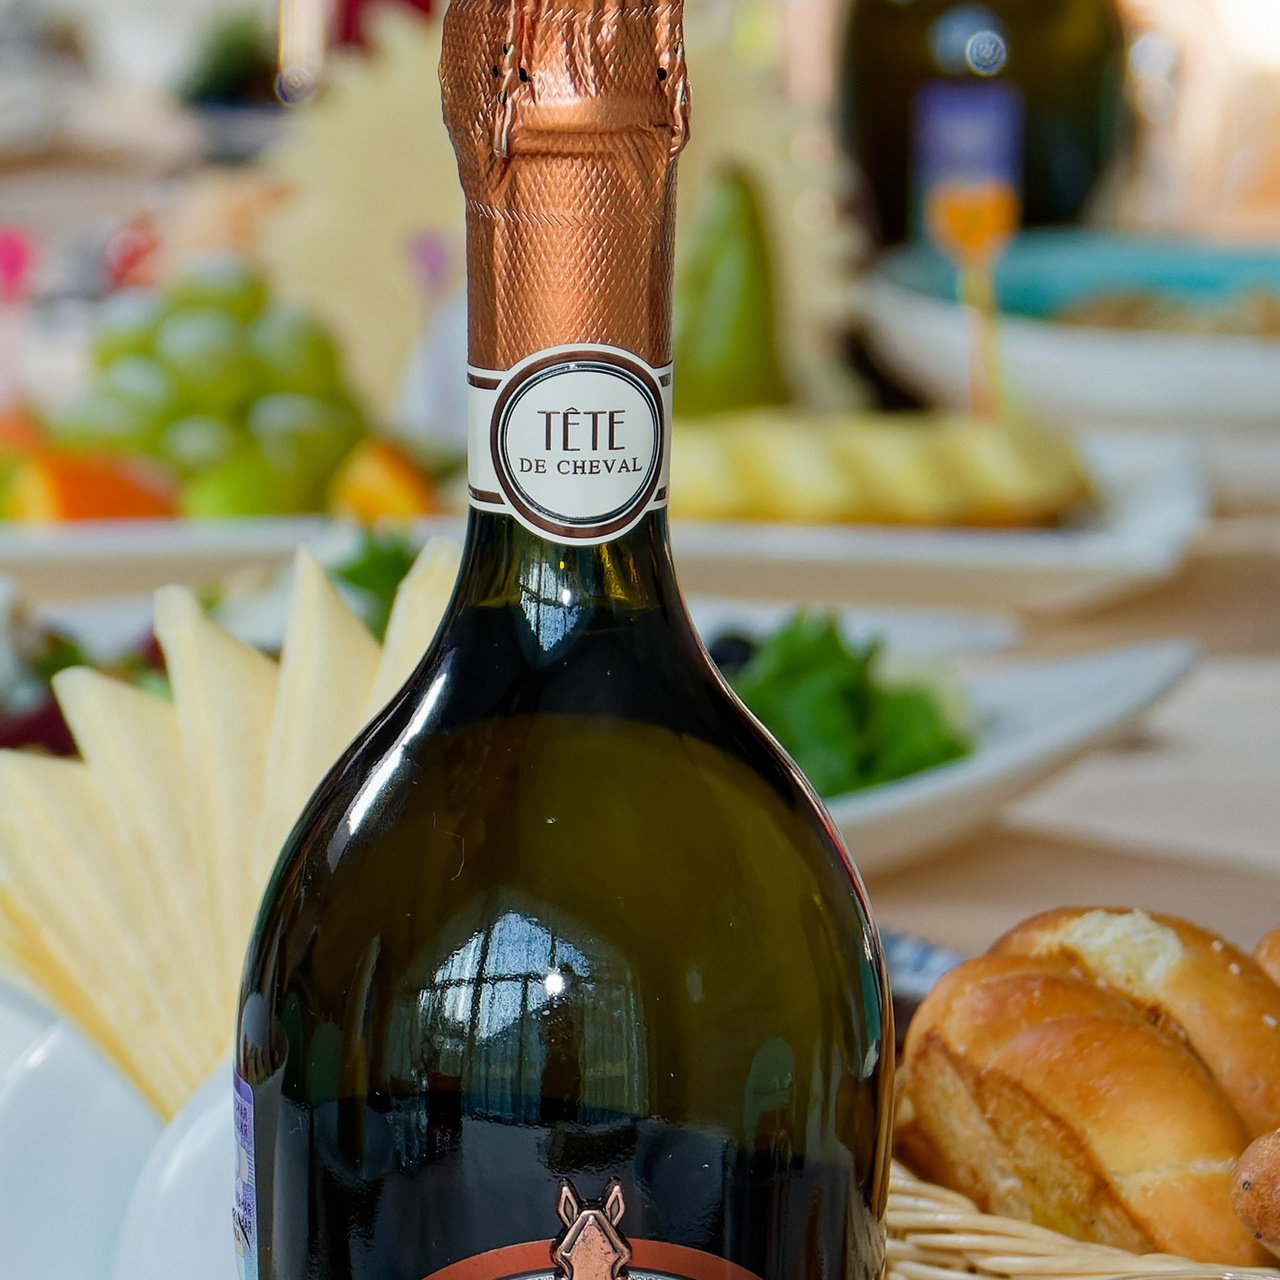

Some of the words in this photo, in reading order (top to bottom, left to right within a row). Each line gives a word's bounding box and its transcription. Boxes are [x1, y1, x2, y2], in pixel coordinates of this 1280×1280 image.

[536, 406, 626, 451] TÊTE
[519, 457, 547, 474] DE
[556, 456, 643, 475] CHEVAL
